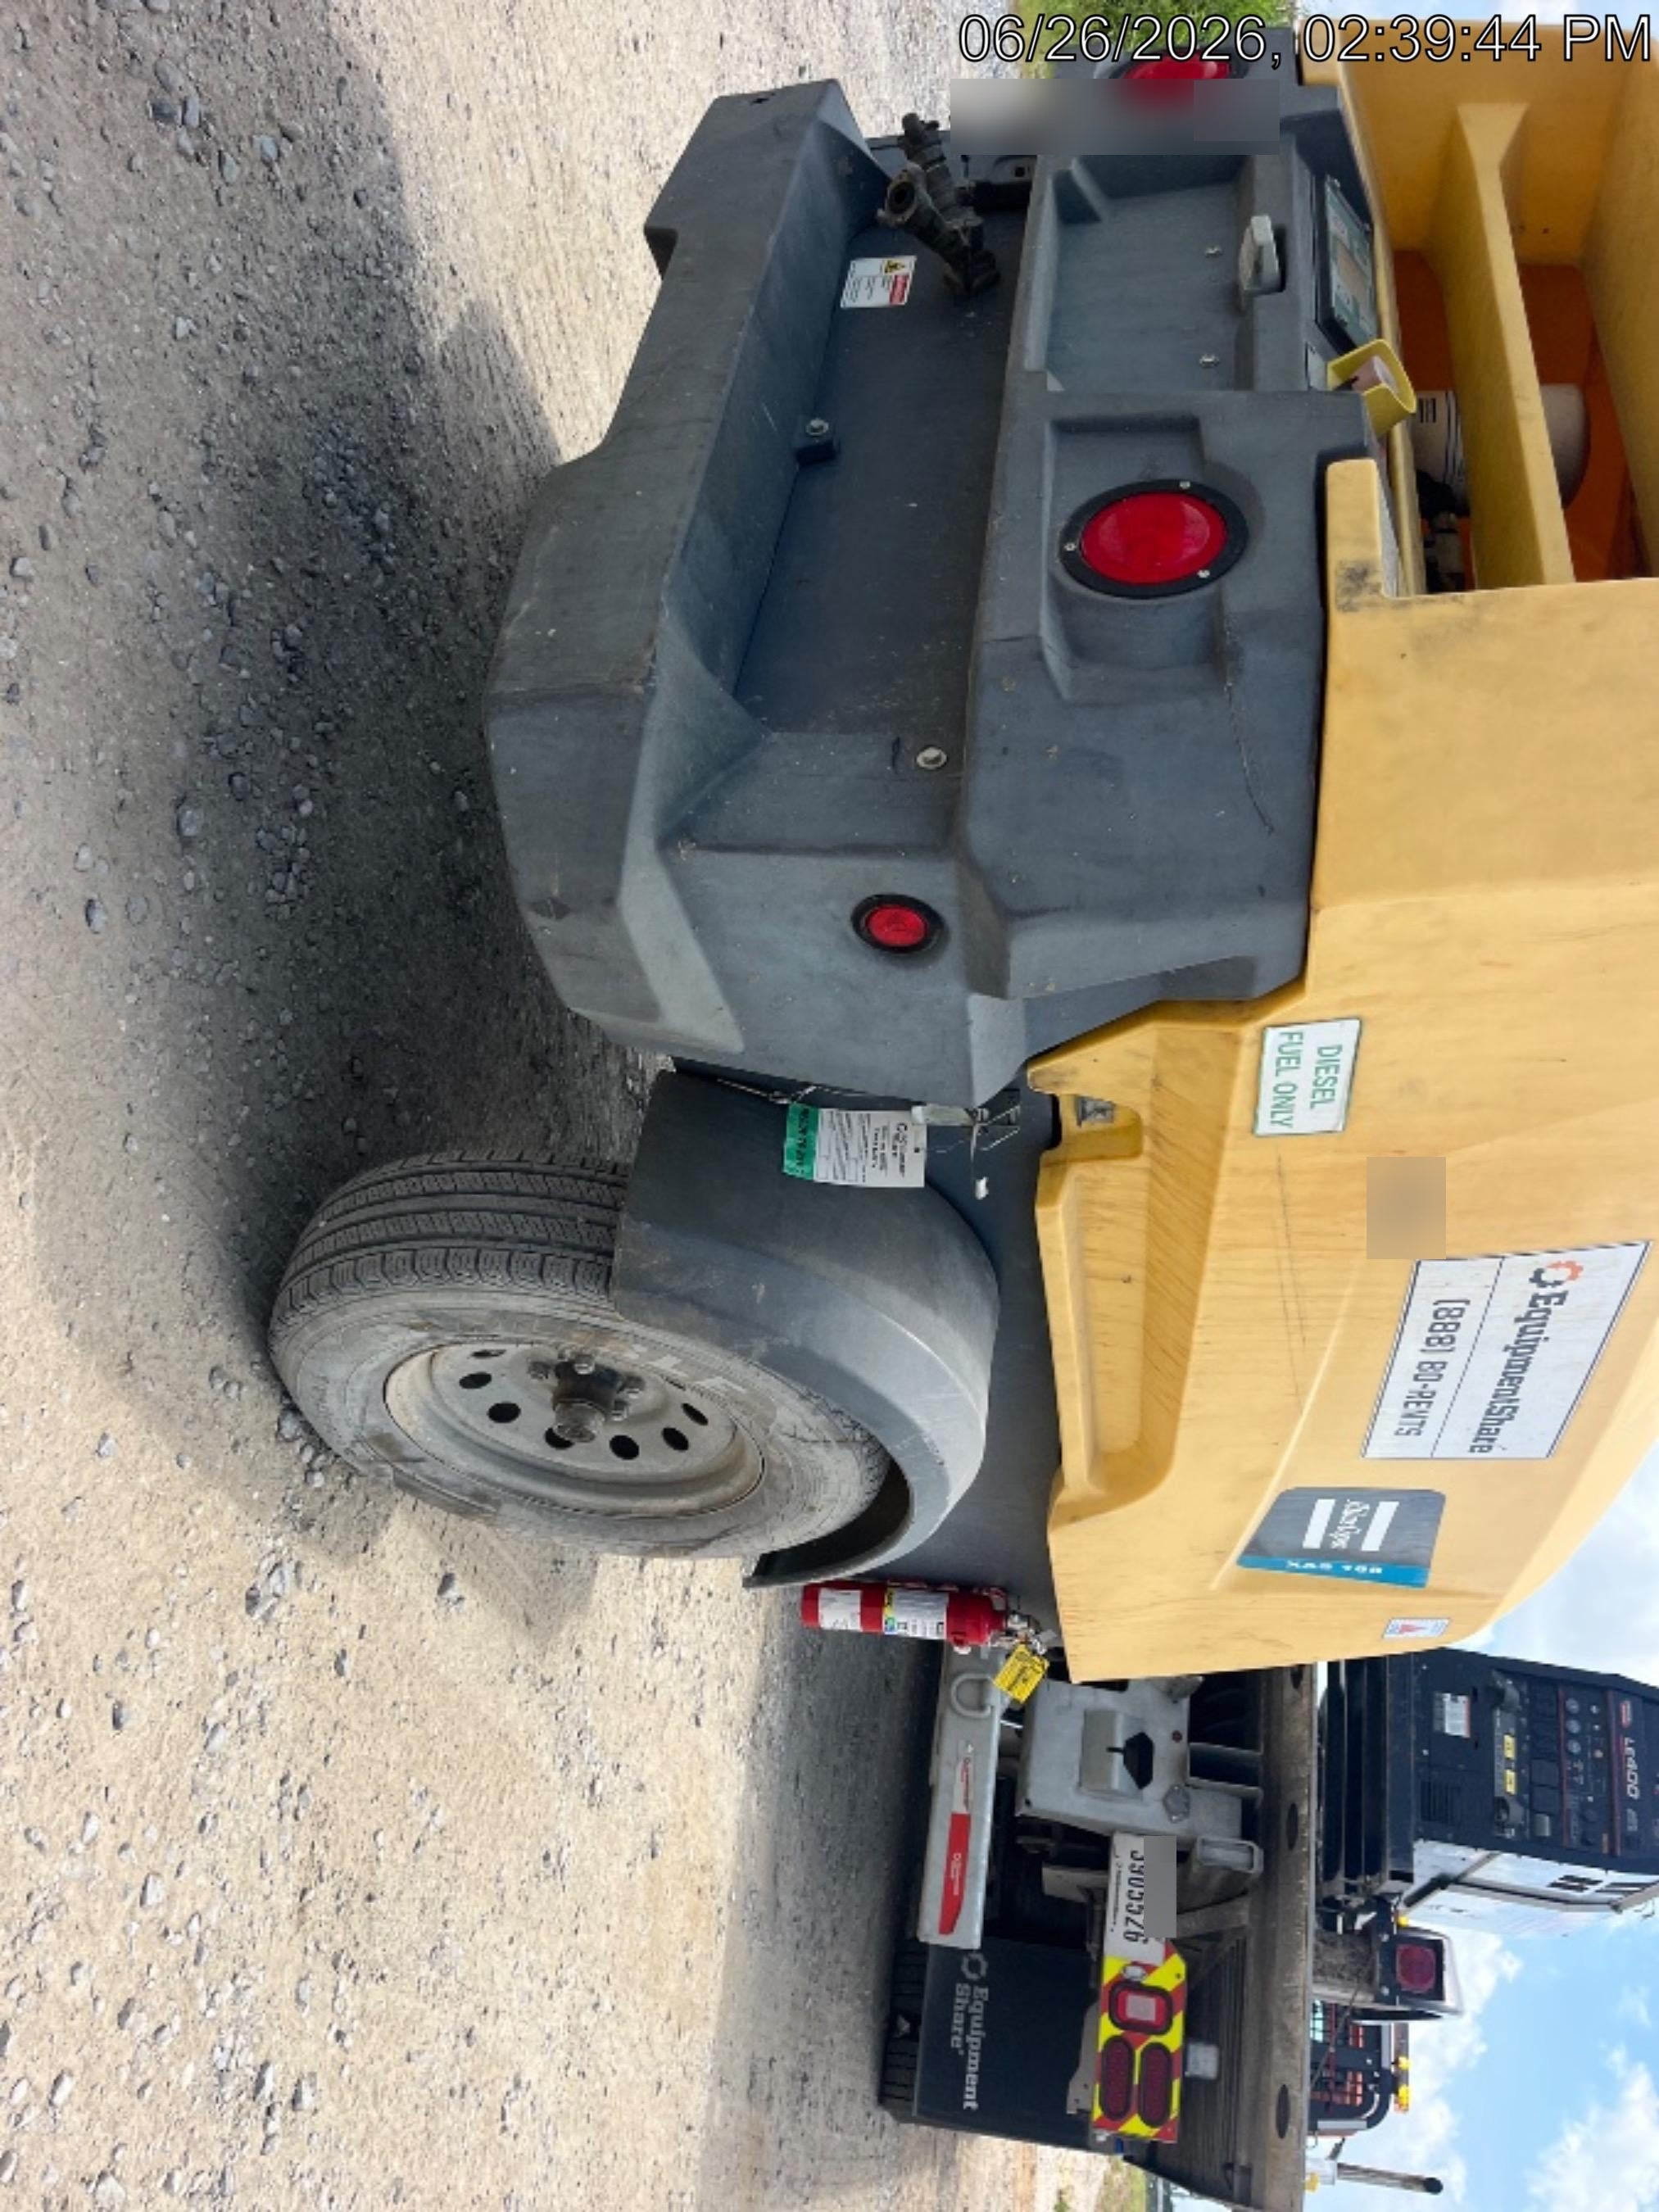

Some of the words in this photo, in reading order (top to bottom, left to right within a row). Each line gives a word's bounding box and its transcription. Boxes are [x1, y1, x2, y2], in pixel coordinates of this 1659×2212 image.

[1275, 1031, 1303, 1077] FUEL
[1310, 1045, 1343, 1110] DIESEL
[1270, 1082, 1299, 1128] ONLY
[1419, 1299, 1471, 1353] (888)
[1468, 1290, 1569, 1454] EquipmentShare
[1624, 1737, 1640, 1800] LE400
[950, 1983, 971, 2049] Share
[963, 1985, 989, 2110] Equipment
